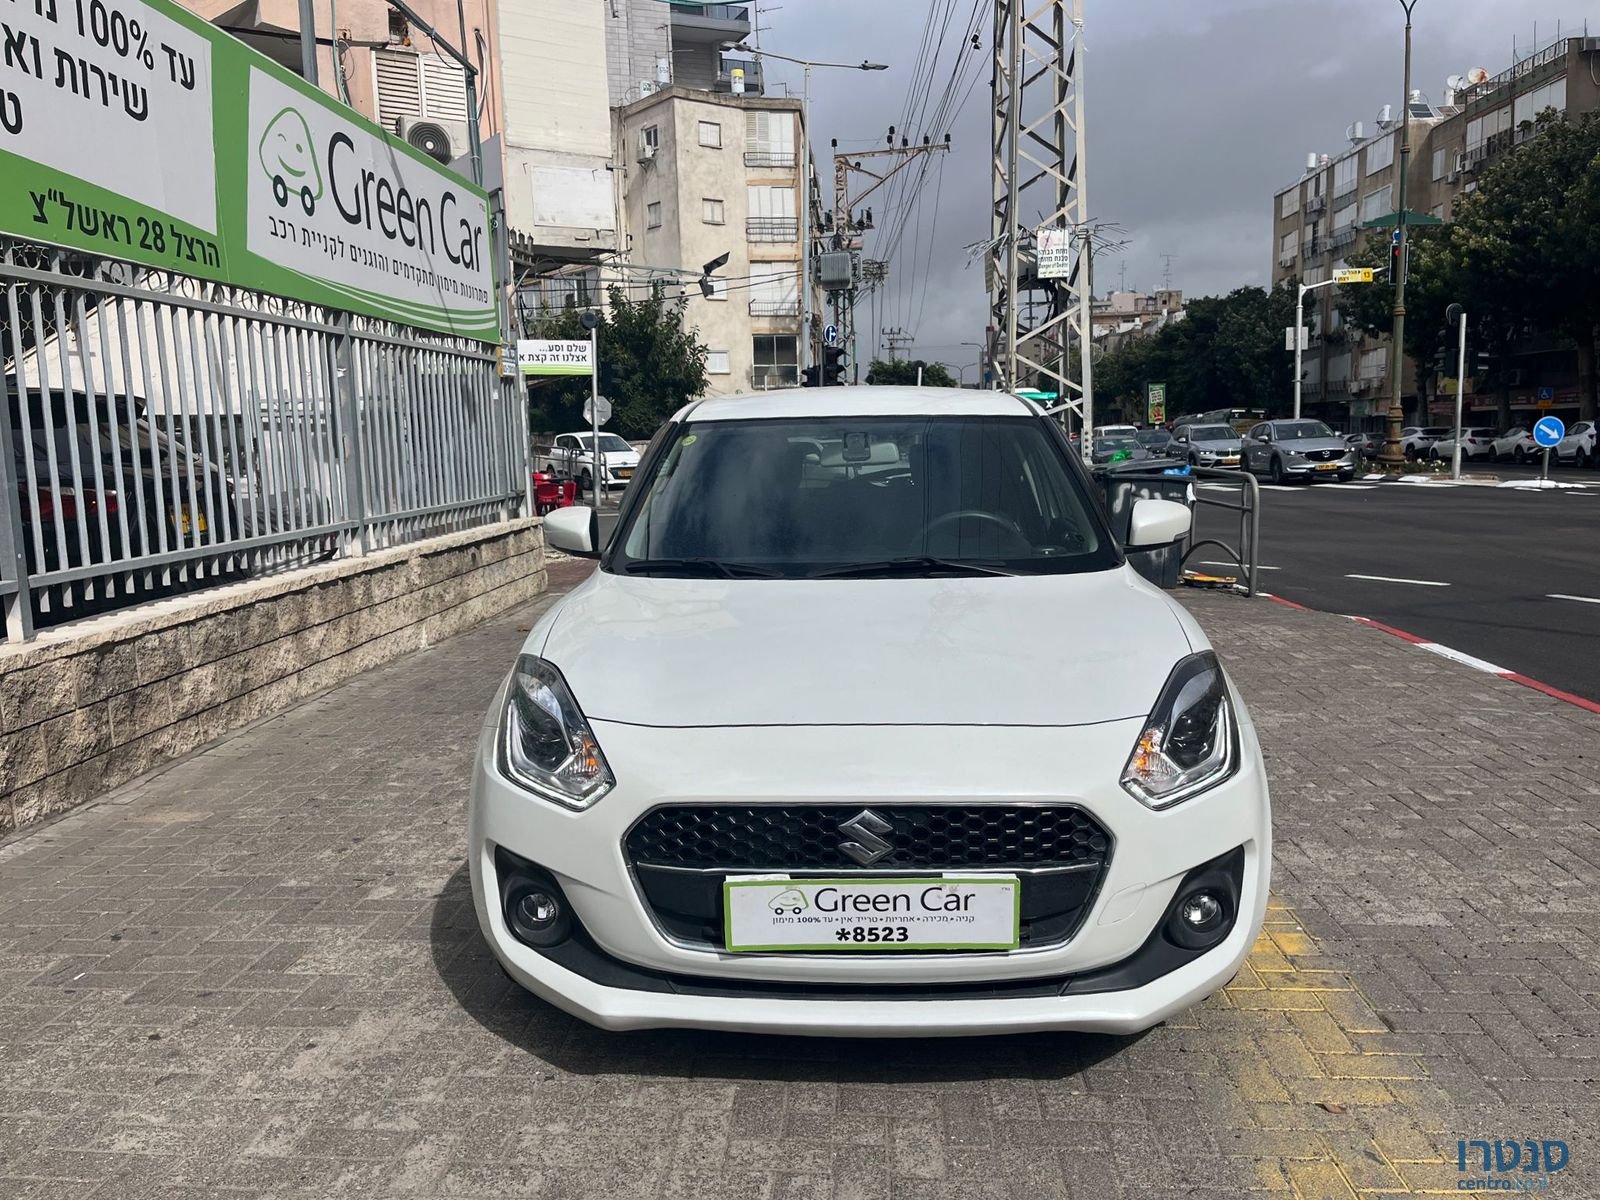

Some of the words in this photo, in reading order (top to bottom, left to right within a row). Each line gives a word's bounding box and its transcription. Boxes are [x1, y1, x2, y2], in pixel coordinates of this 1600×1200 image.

[76, 0, 154, 70] 100%
[161, 43, 195, 90] עד
[54, 47, 148, 121] שירות
[328, 132, 435, 255] Green
[440, 191, 481, 272] Car
[137, 217, 166, 253] 28
[268, 216, 296, 242] רכב
[170, 224, 220, 268] הרצל
[302, 227, 344, 260] לקניית
[350, 244, 389, 272] והוגנים
[392, 258, 435, 287] מתקדמים
[437, 274, 459, 294] מימון
[460, 282, 488, 303] פתרונות
[528, 353, 547, 363] קצת
[563, 353, 587, 362] אצלנו
[567, 343, 587, 352] שלם
[814, 887, 911, 912] Green
[920, 887, 976, 911] Car
[840, 916, 856, 924] אין
[956, 916, 975, 924] קניה
